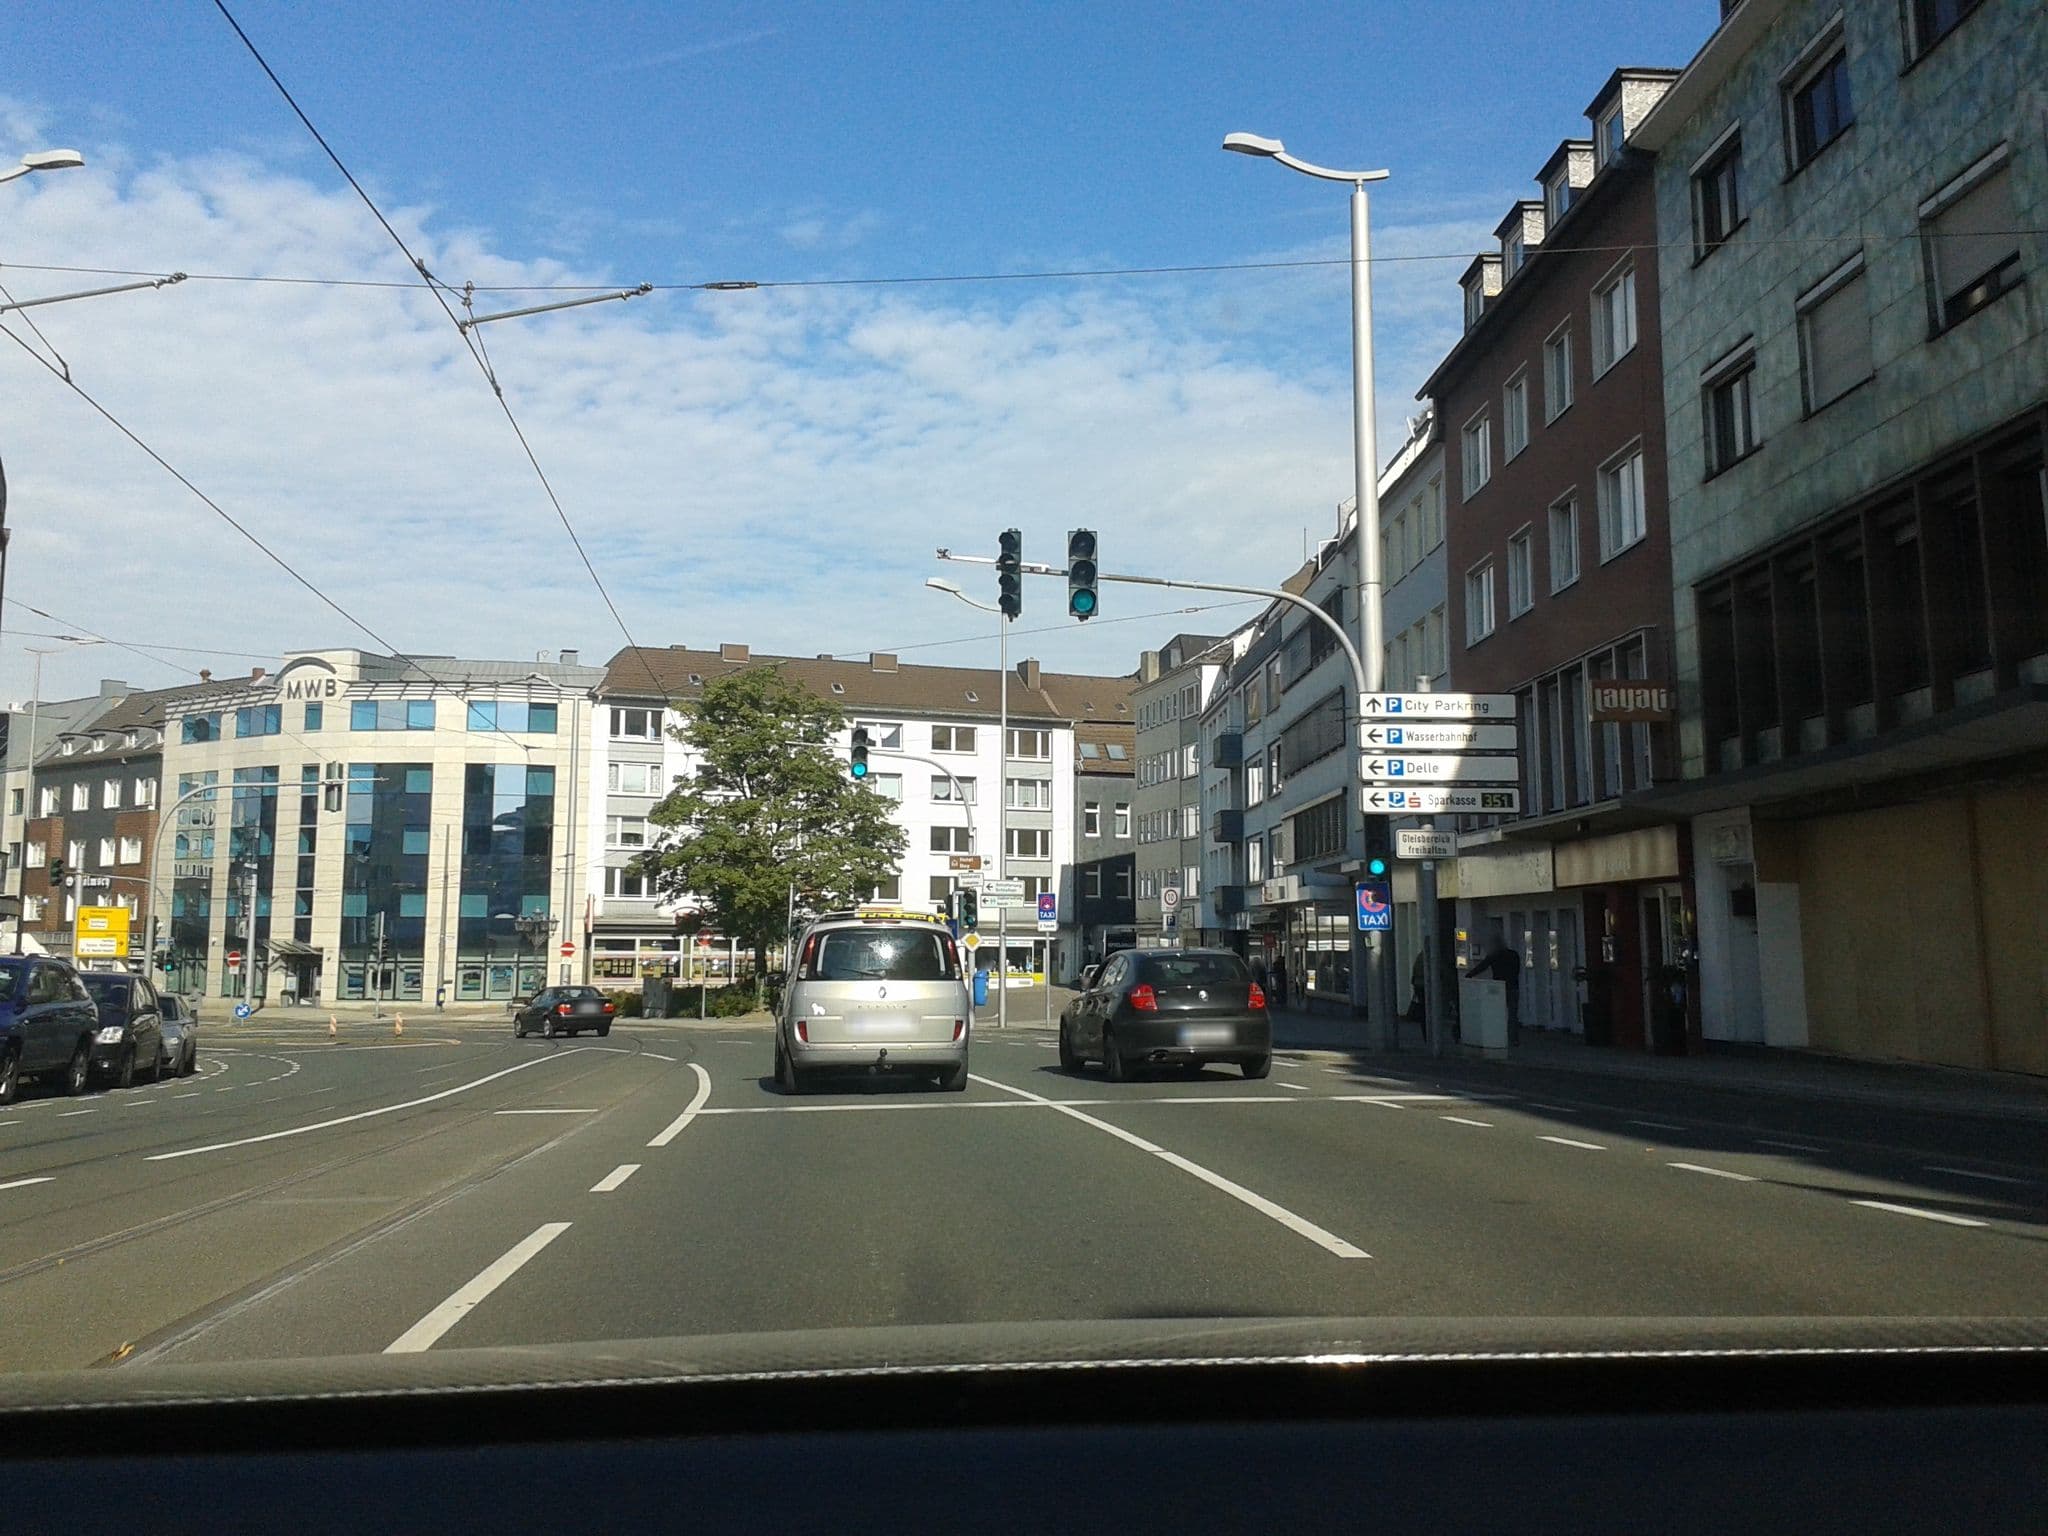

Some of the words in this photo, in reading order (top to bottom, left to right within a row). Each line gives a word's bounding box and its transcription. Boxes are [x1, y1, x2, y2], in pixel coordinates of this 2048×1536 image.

[287, 678, 337, 700] MWB
[1405, 699, 1429, 713] City
[1435, 699, 1489, 714] Parkring
[1406, 731, 1478, 742] Wasserbahnhof
[1407, 762, 1440, 773] Delle
[1428, 794, 1477, 807] Sparkasse
[1484, 794, 1511, 807] 351
[1402, 833, 1450, 843] Gleisbereich
[1408, 845, 1447, 855] freihalten
[1040, 911, 1056, 919] TAXI
[1362, 913, 1389, 926] TAXI
